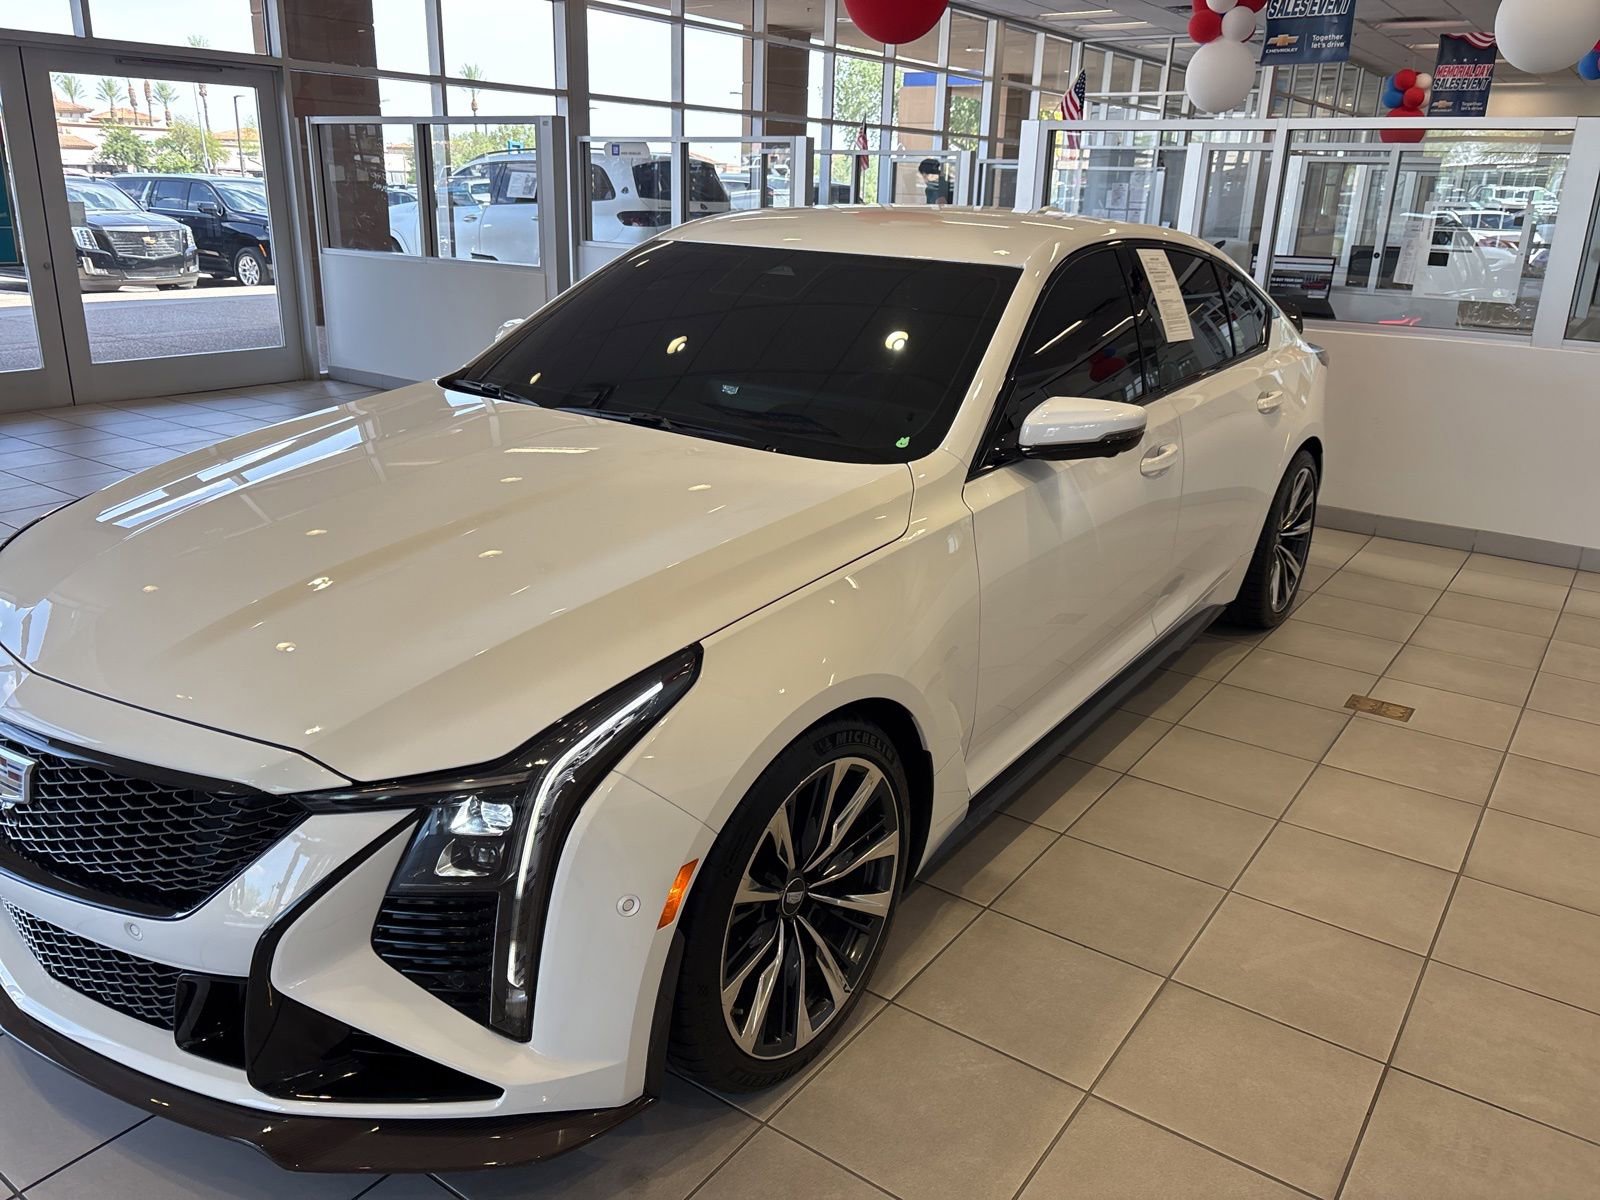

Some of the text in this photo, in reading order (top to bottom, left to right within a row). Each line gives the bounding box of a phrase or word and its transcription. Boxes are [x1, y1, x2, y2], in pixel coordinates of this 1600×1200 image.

[1312, 34, 1343, 42] Together
[1434, 64, 1494, 78] MEMORIAL DAY
[1432, 77, 1491, 90] SALES EVENT
[836, 731, 896, 761] MICHELIN
